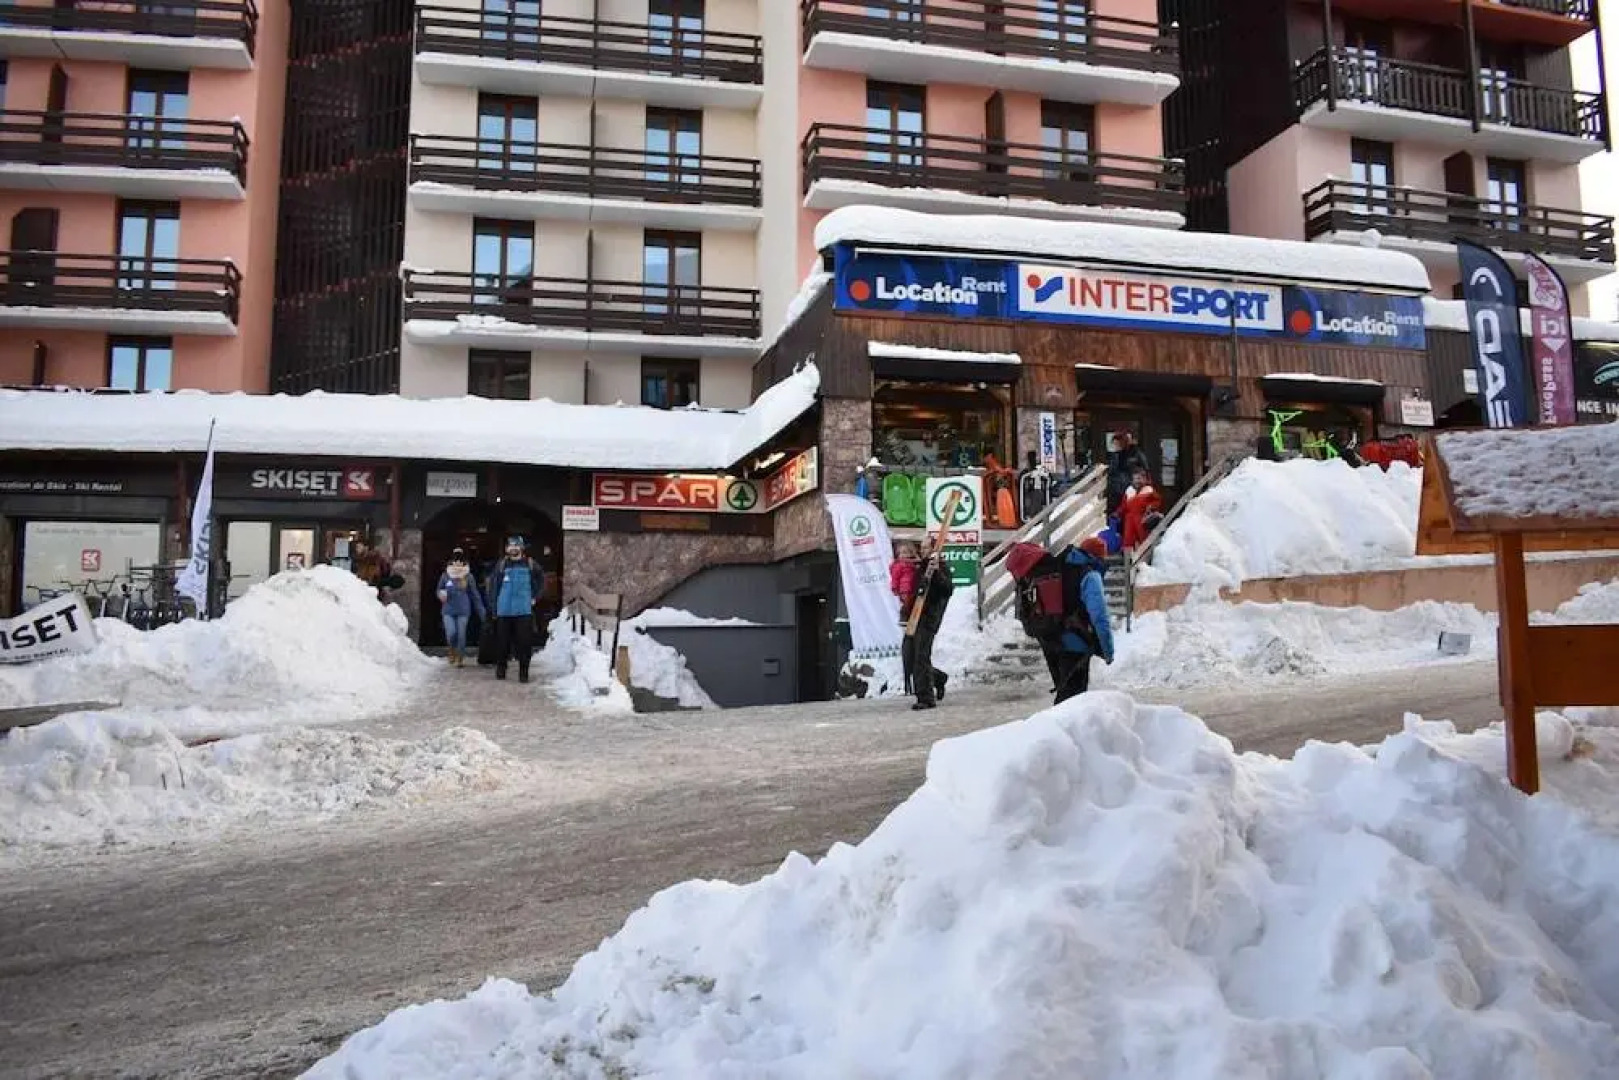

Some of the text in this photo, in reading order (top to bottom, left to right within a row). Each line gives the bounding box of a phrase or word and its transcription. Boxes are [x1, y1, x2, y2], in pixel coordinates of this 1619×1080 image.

[961, 276, 1007, 293] Rent
[1070, 277, 1269, 321] INTERSPORT
[1384, 311, 1419, 325] Rent
[251, 470, 343, 489] SKISET
[600, 481, 714, 504] SPAR
[0, 604, 78, 650] ISET
